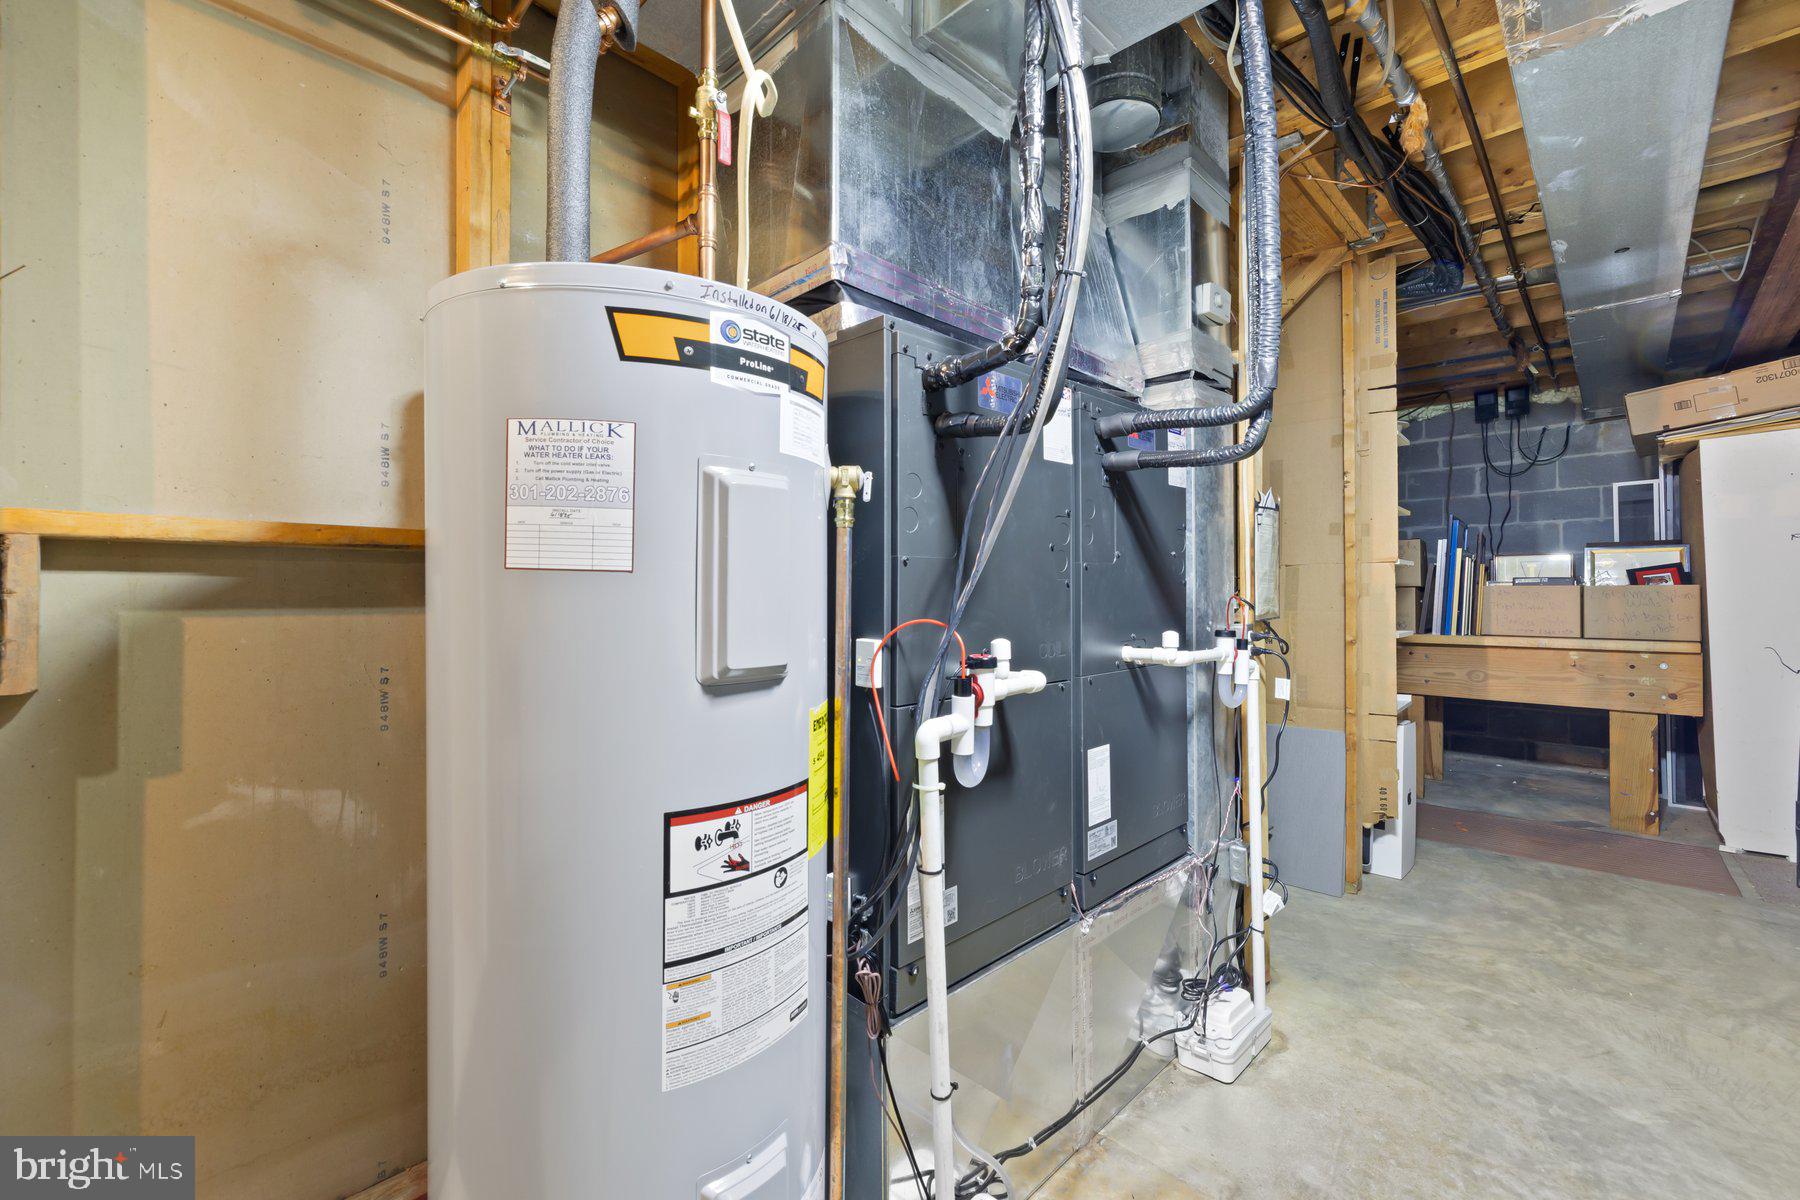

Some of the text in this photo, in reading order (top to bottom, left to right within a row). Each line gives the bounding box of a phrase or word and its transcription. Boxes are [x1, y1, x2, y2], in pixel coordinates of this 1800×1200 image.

[700, 284, 754, 310] Installed
[755, 305, 768, 315] on
[742, 328, 785, 351] state
[726, 374, 763, 387] COMMERCIAL
[1756, 368, 1800, 384] 0071302
[517, 420, 625, 439] MALLICK
[523, 451, 614, 461] WATER HEATER LEAKS:
[528, 444, 550, 452] WHAT
[577, 445, 585, 453] IF
[586, 446, 609, 454] YOUR
[509, 483, 631, 504] 301-202-2876
[743, 800, 771, 813] DANGER
